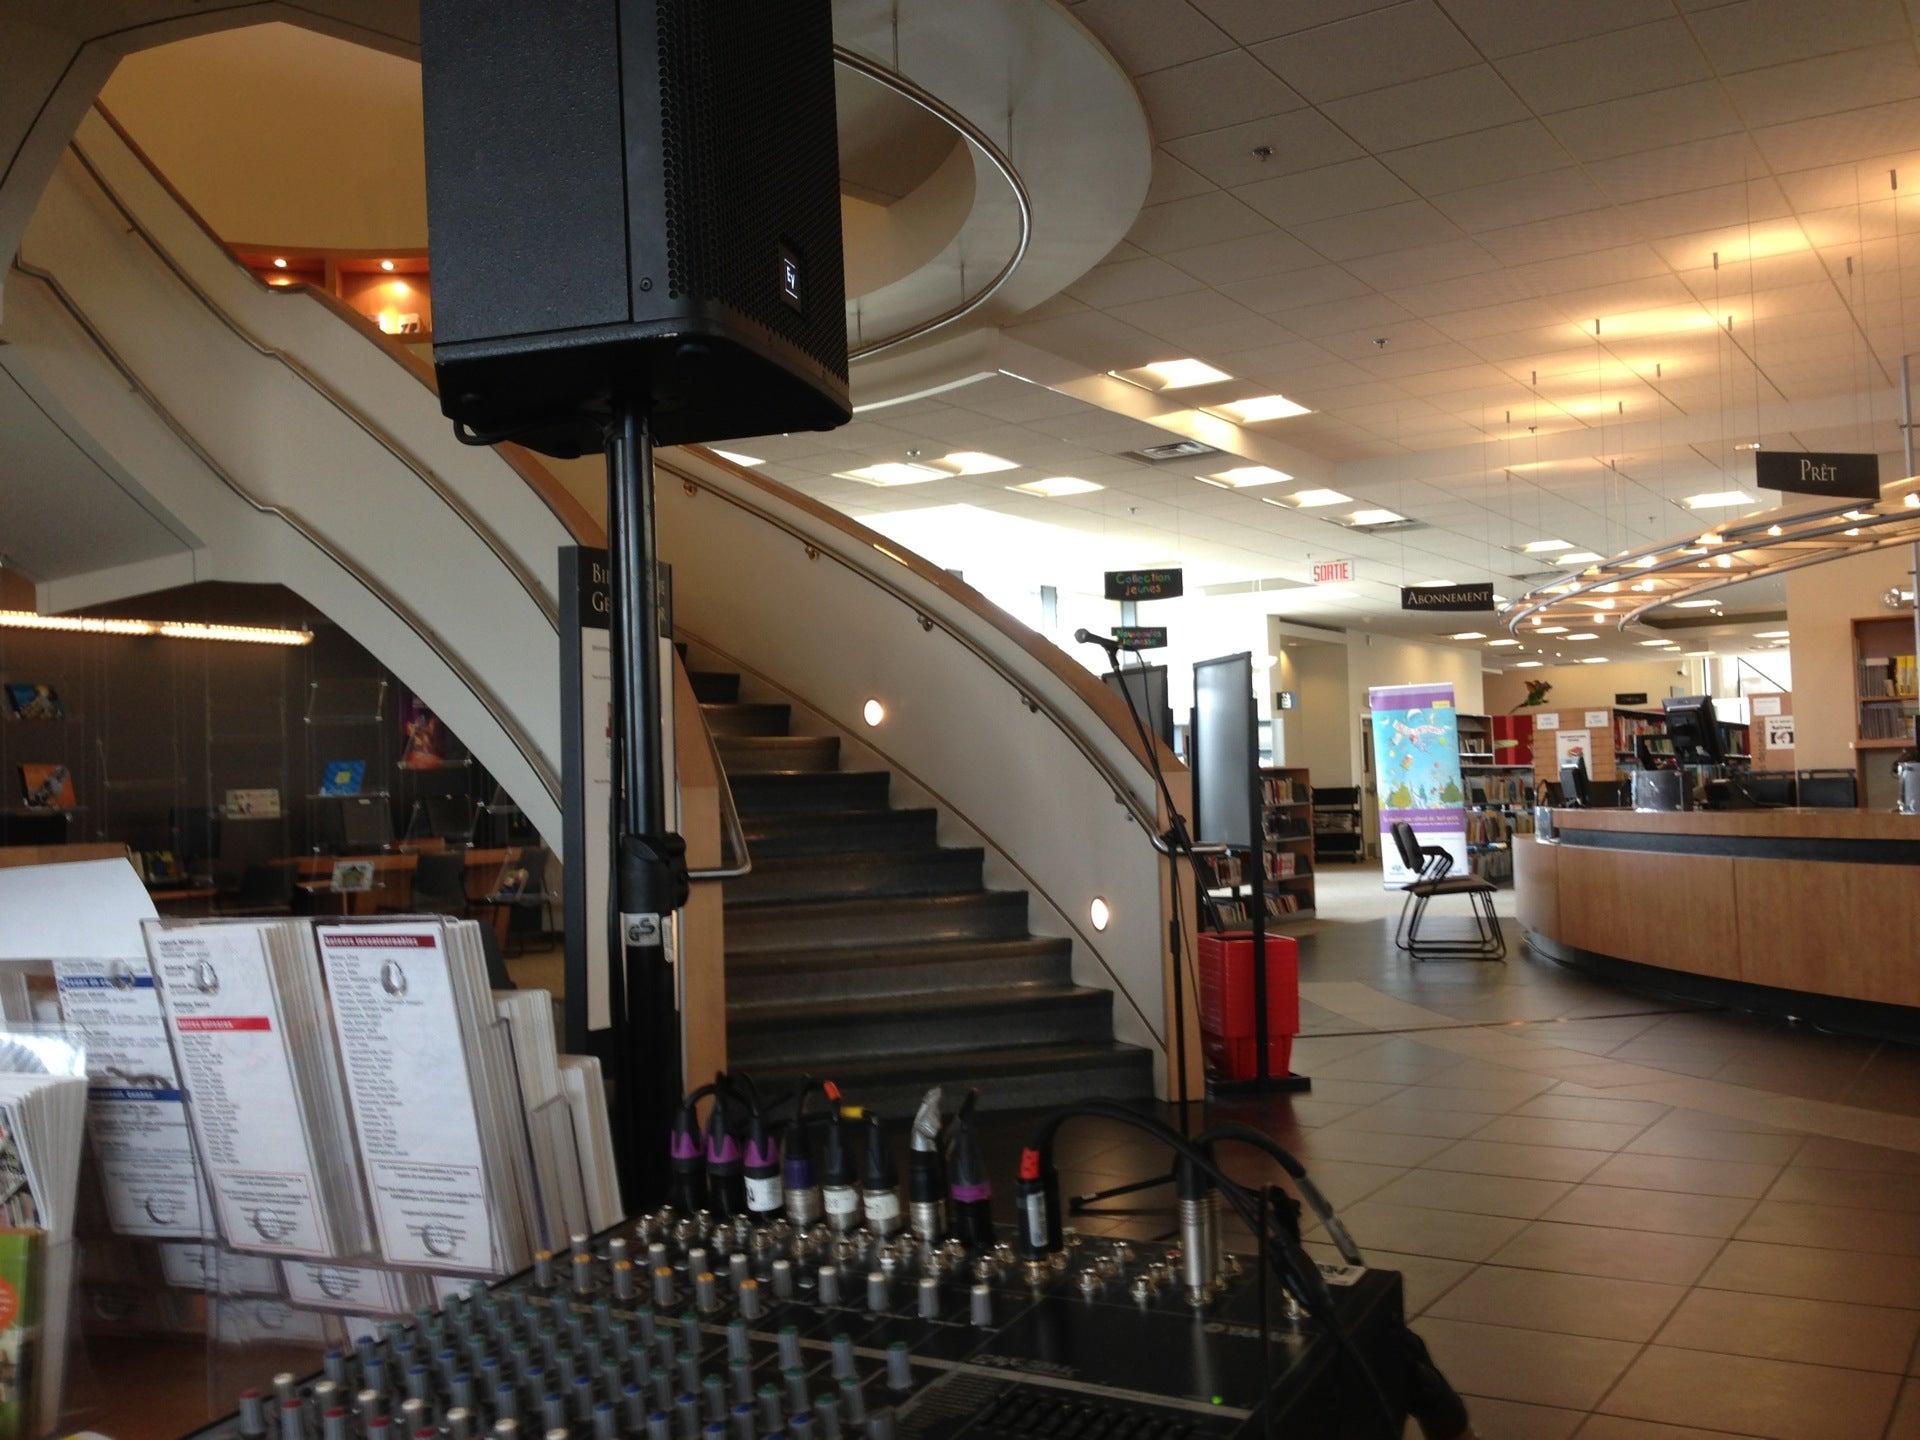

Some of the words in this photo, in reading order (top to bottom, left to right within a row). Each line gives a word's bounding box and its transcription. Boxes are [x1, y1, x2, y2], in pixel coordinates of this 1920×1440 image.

[1800, 459, 1838, 481] PRÊT
[1115, 572, 1171, 584] Collection
[1313, 563, 1349, 582] SORTIE
[1407, 591, 1489, 605] ABONNEMENT
